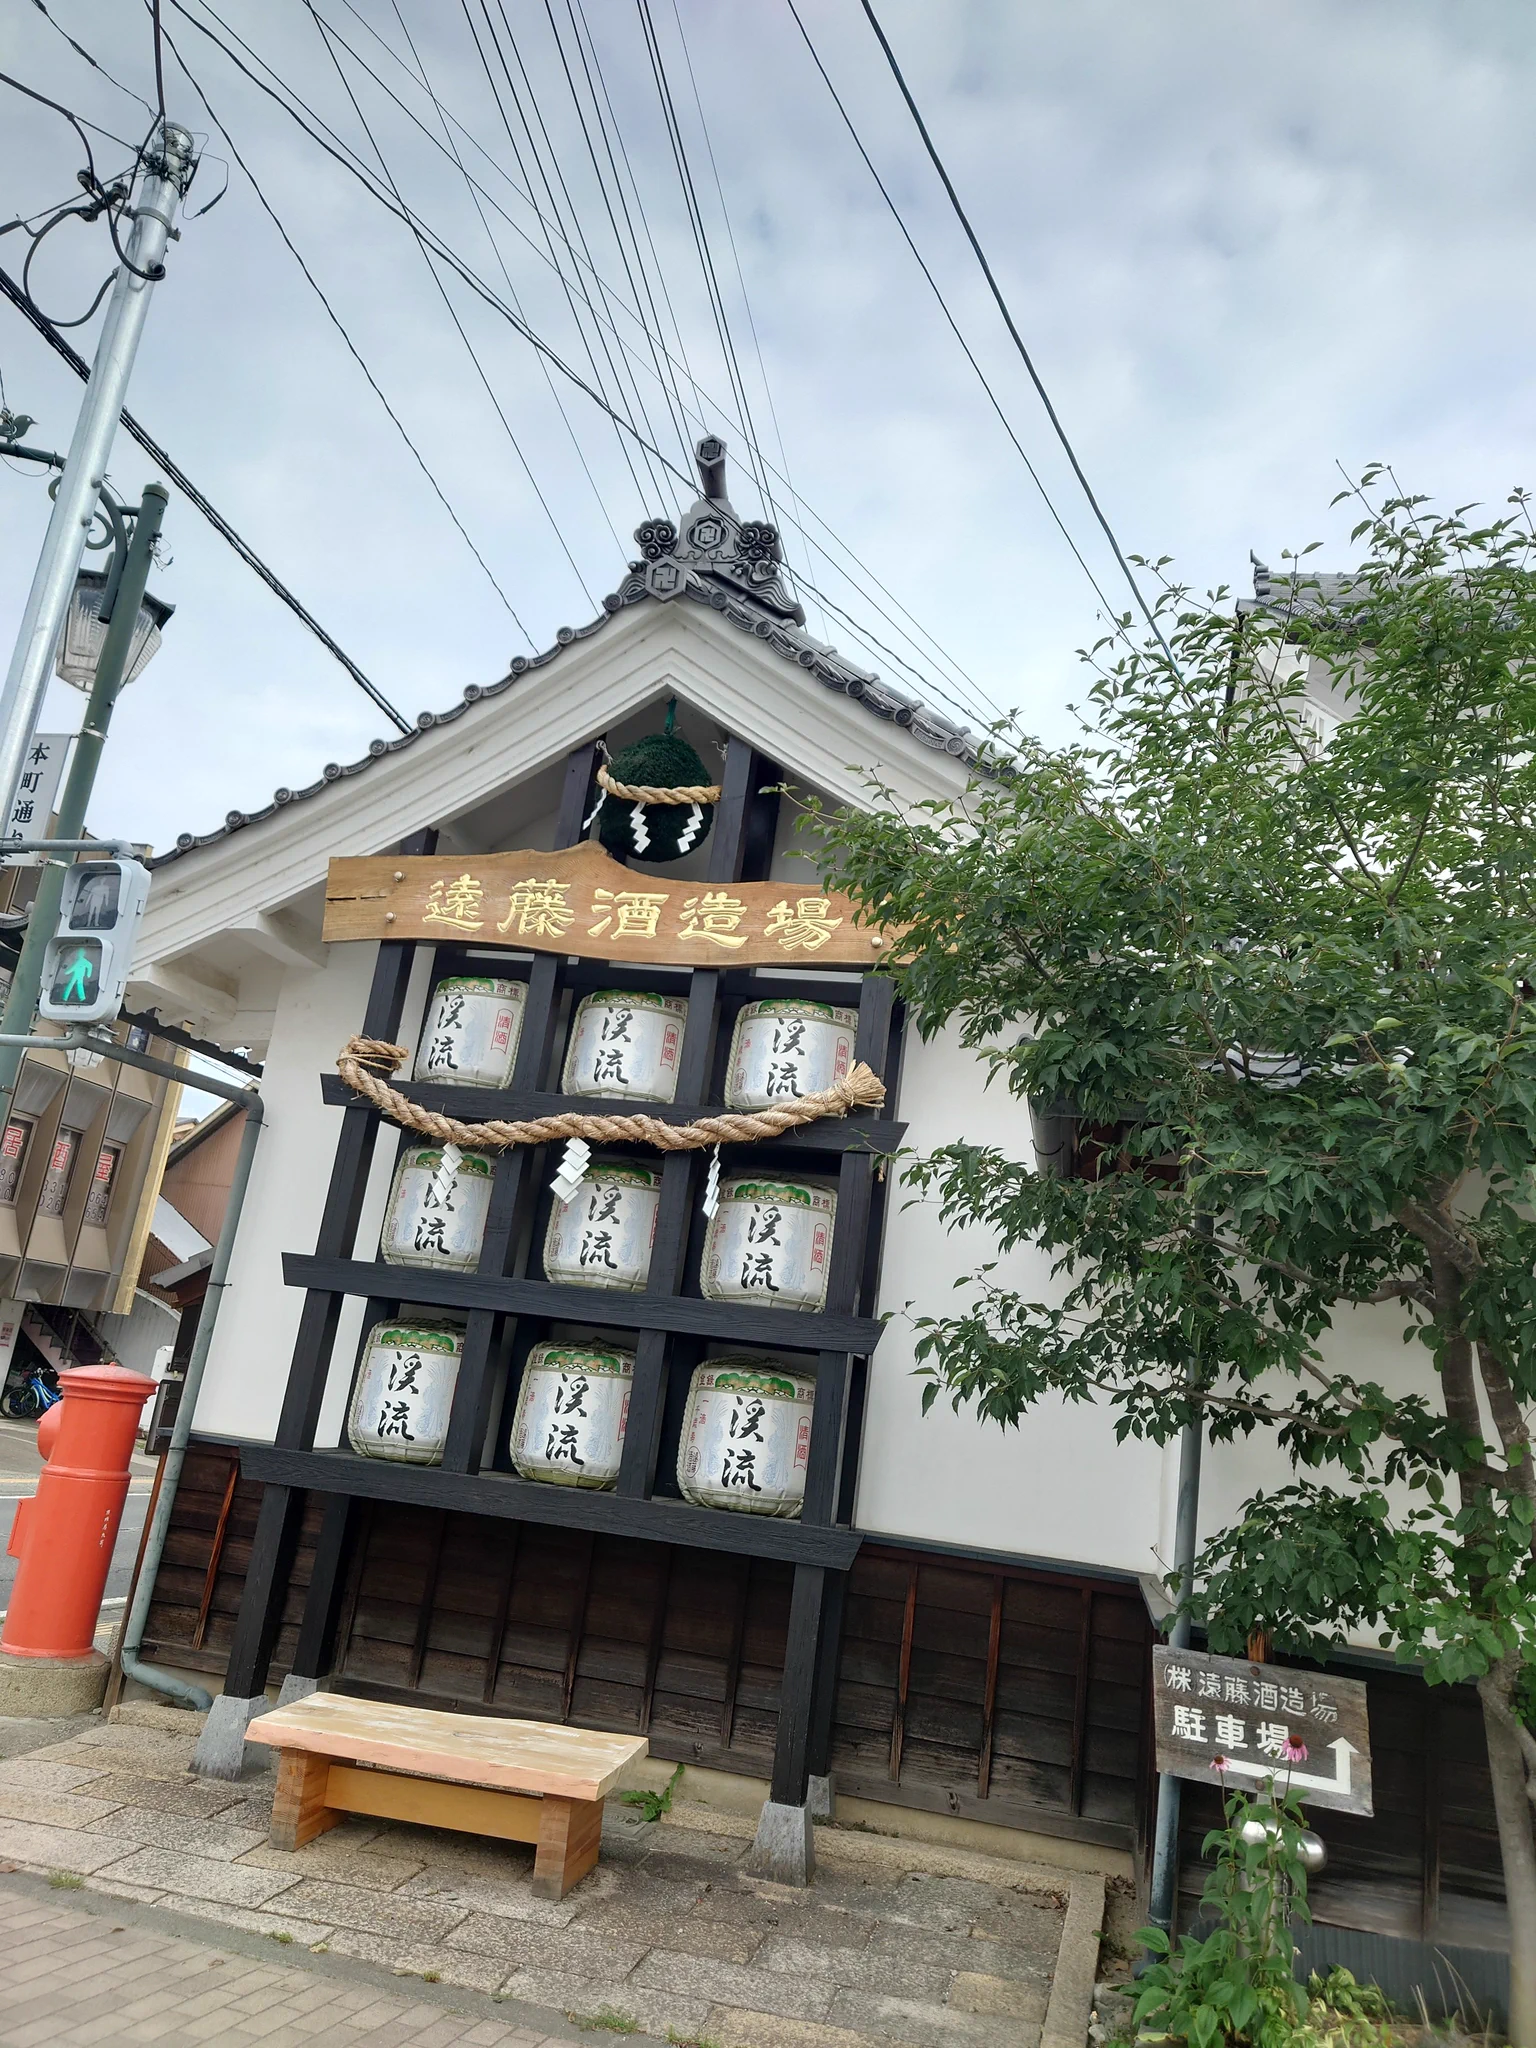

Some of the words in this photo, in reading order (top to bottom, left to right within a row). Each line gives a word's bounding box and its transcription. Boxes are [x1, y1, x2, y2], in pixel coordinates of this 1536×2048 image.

[422, 873, 843, 950] 遠藤酒造場
[1172, 1705, 1290, 1761] 駐車場
